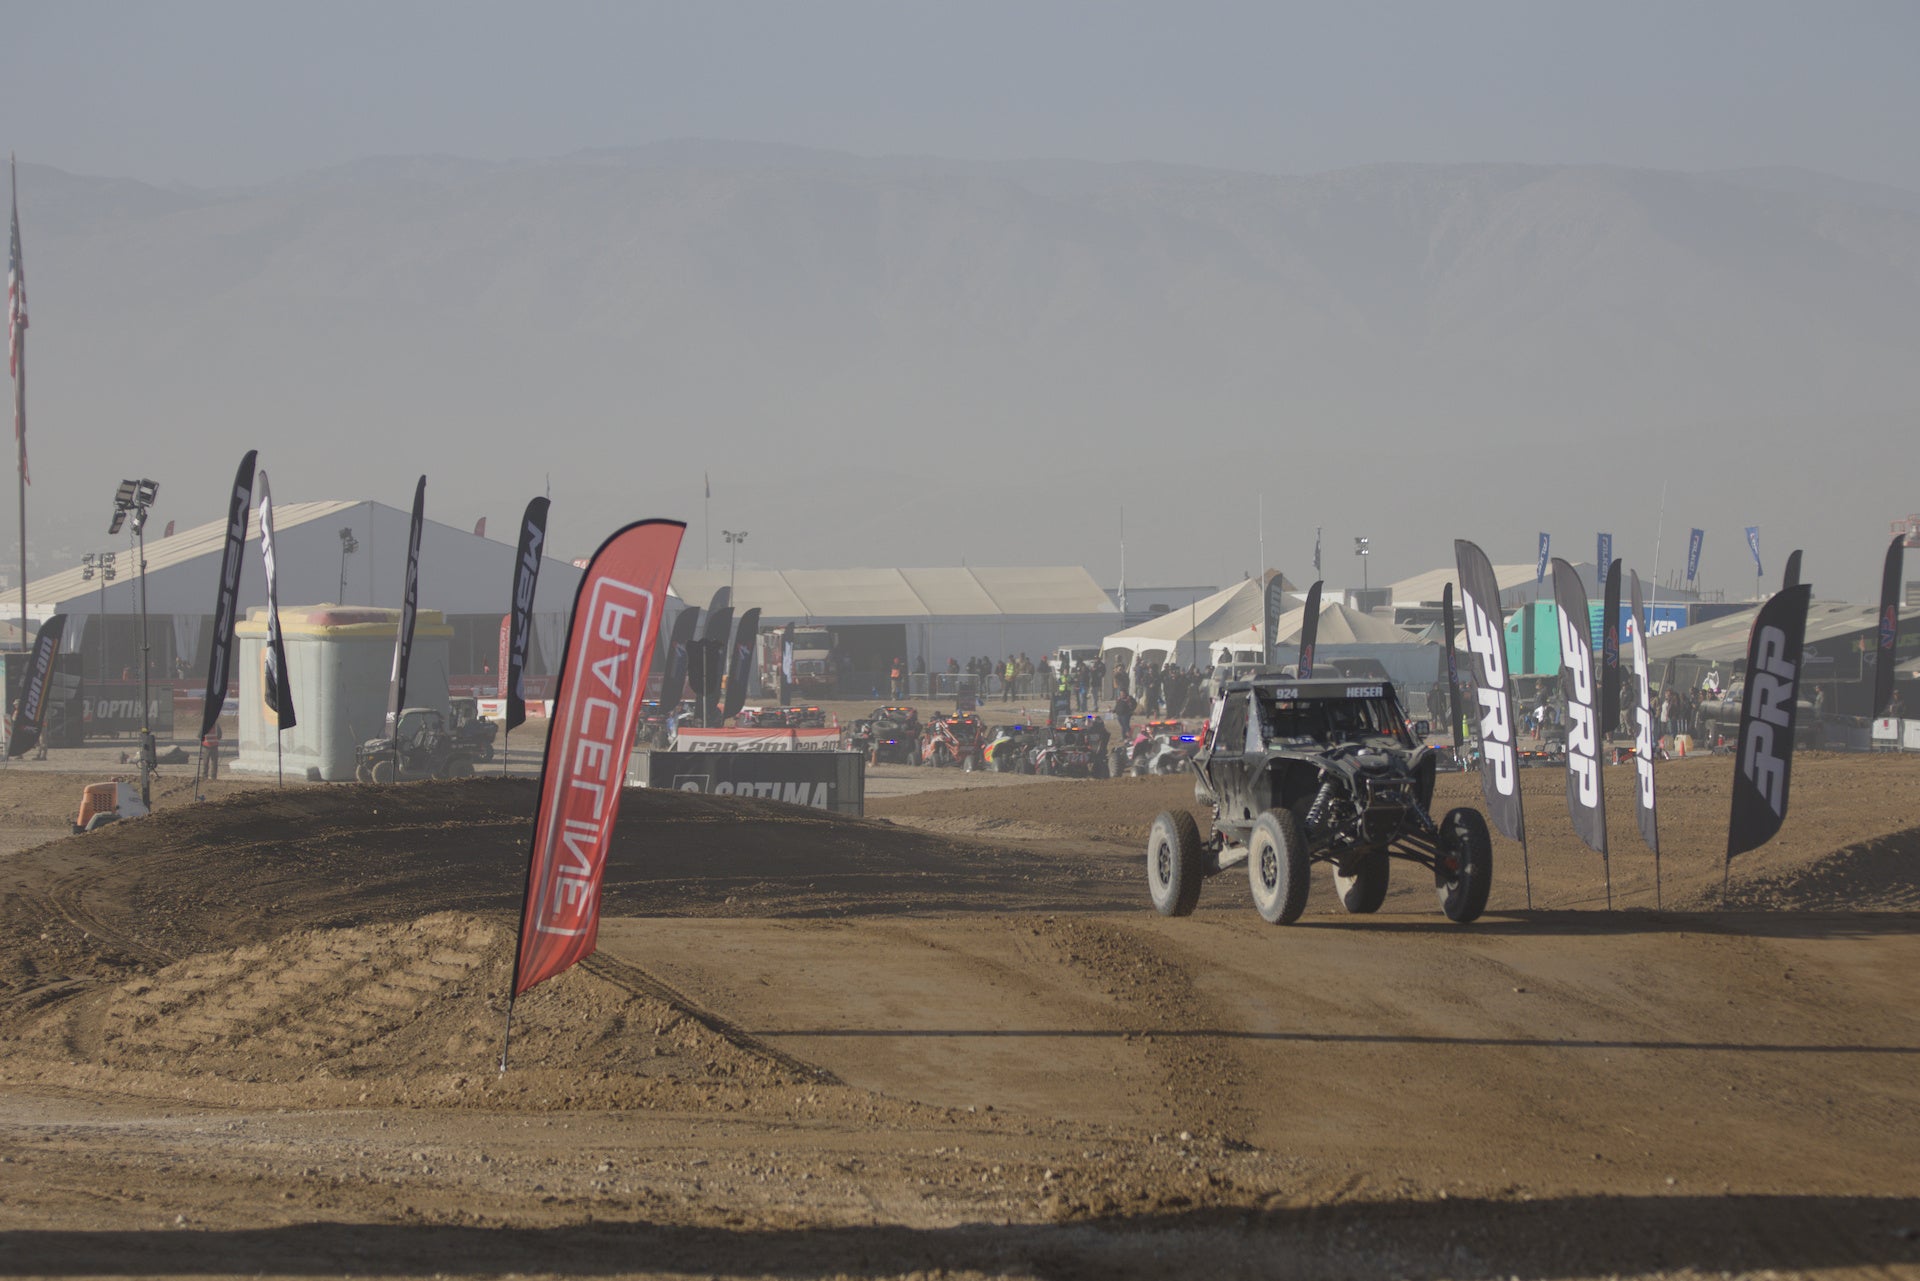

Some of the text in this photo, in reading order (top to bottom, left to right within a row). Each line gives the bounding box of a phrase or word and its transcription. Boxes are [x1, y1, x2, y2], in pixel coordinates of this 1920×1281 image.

[213, 485, 250, 696] MBRP
[1626, 618, 1677, 638] FKEN
[25, 636, 53, 721] can-am
[1277, 688, 1298, 699] 924
[1346, 687, 1383, 698] HEISER
[1462, 588, 1515, 796] PRP
[1557, 604, 1598, 808] PRP
[1744, 625, 1798, 819] PRP
